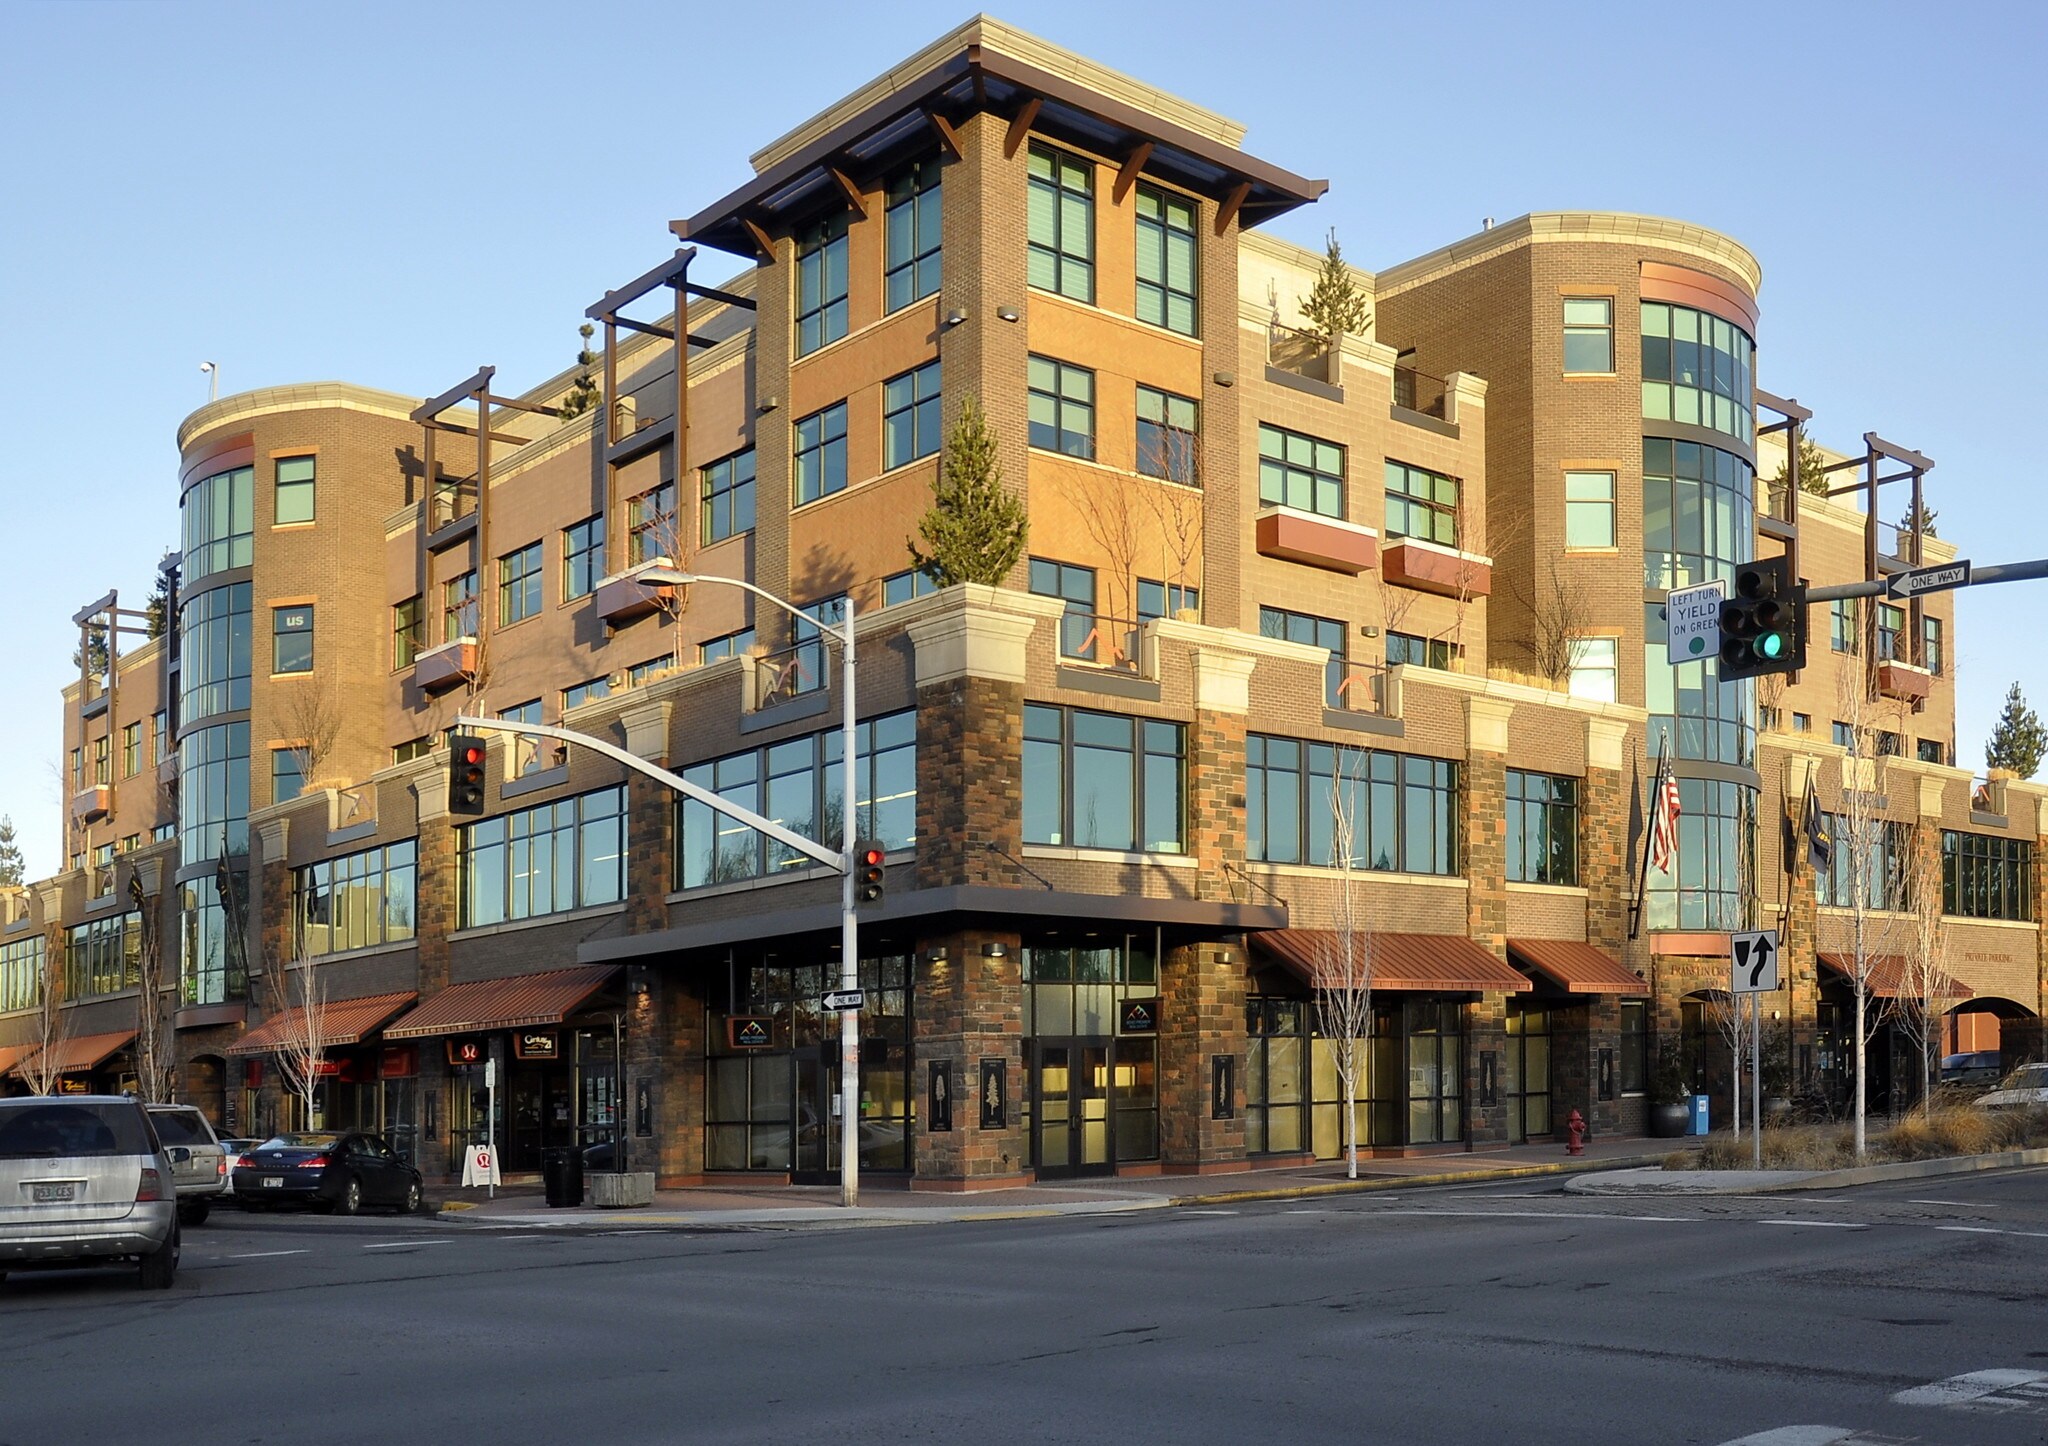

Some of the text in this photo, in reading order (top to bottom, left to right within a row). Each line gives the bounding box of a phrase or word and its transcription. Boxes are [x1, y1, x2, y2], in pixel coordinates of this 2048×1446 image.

[1911, 569, 1961, 589] ONE WAY
[1672, 587, 1721, 606] LEFT TURN
[1678, 602, 1716, 620] YIELD
[286, 615, 304, 627] us
[1673, 617, 1720, 636] ON GREEN
[1671, 964, 1710, 977] FRANKLIN
[833, 995, 860, 1005] ONE WAY
